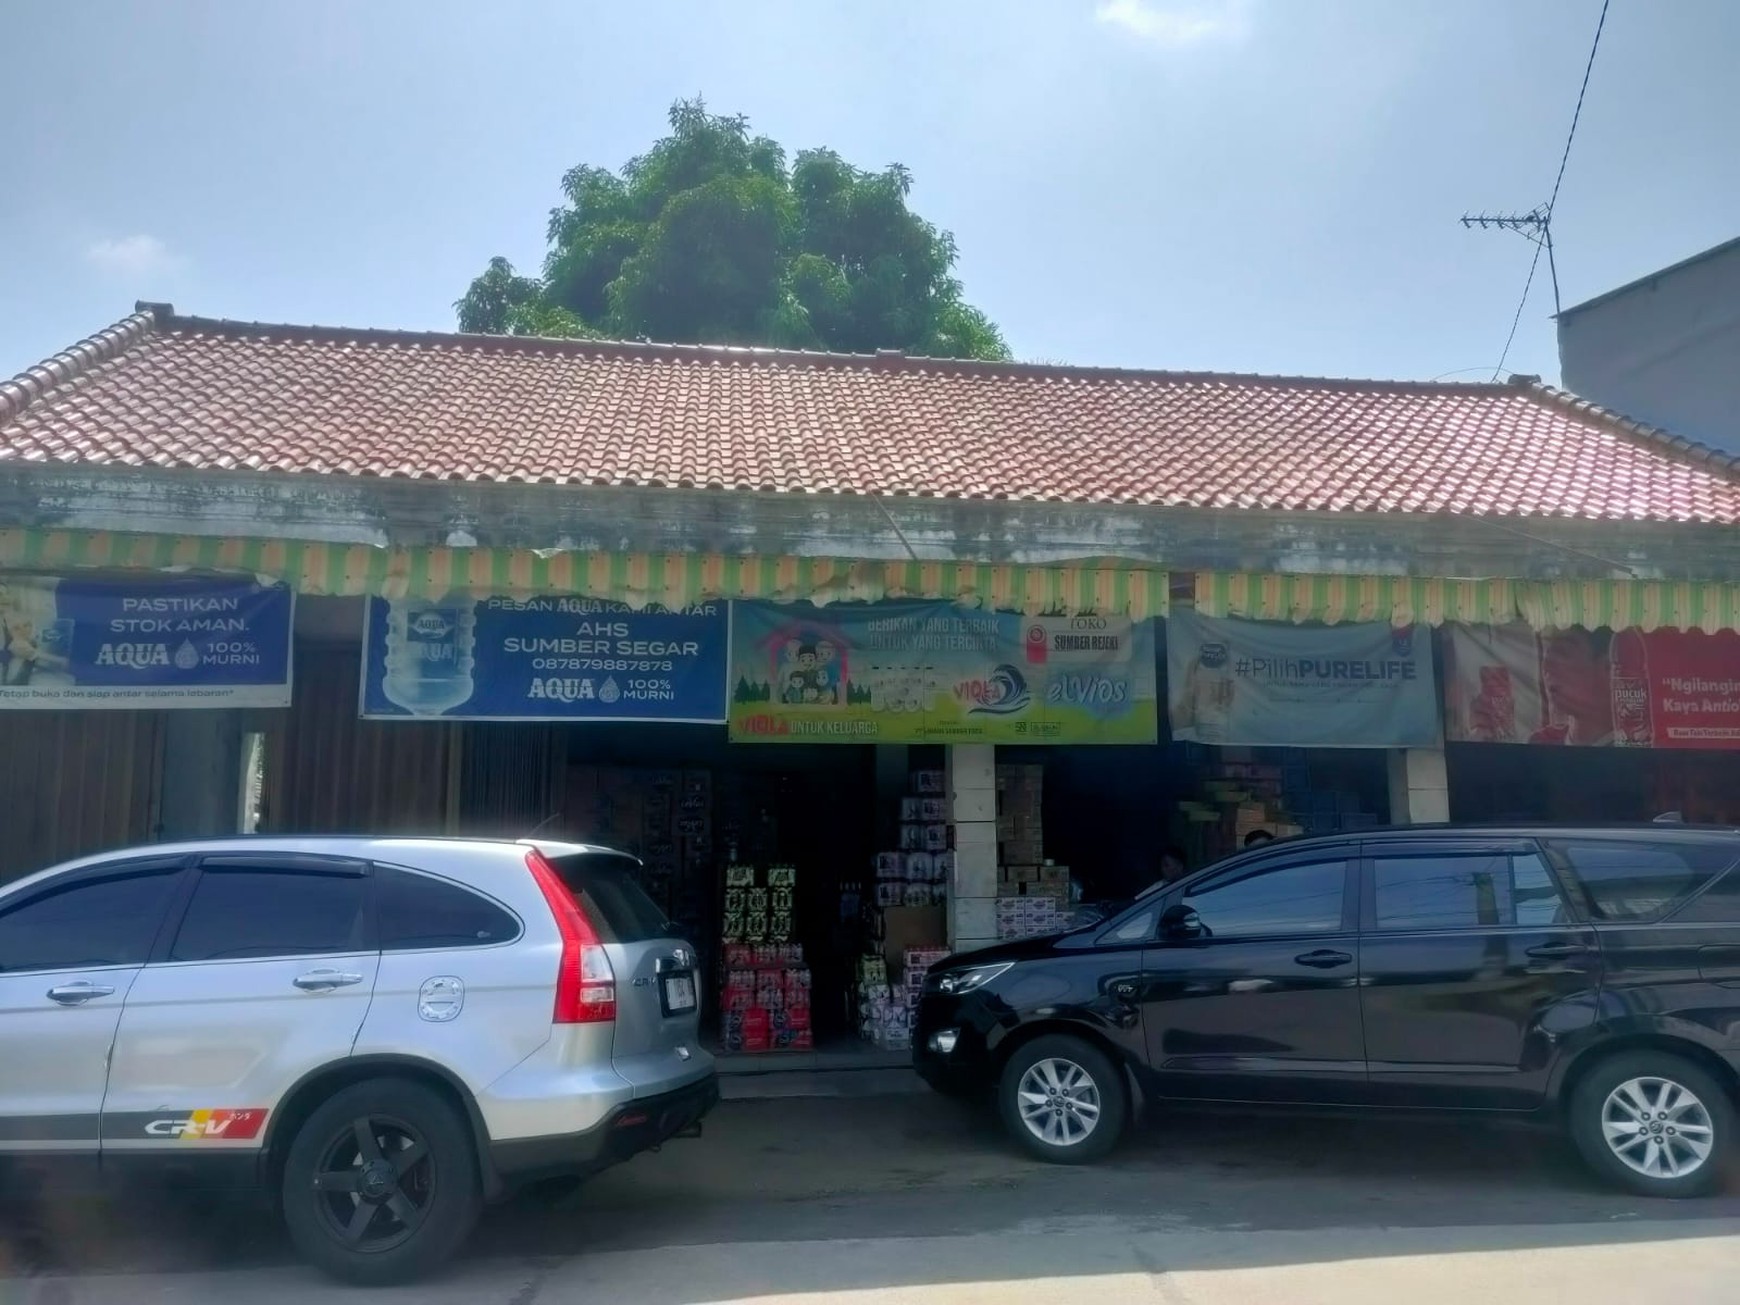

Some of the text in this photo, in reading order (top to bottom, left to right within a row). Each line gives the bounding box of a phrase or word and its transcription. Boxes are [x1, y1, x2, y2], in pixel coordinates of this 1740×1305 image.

[122, 598, 239, 612] PASTIKAN
[488, 600, 552, 612] PESAN
[557, 598, 602, 615] AQUA
[110, 619, 250, 633] STOK AMAN.
[577, 622, 629, 637] AHS
[920, 617, 949, 633] YANG
[953, 618, 1000, 635] TERBAIK
[1070, 617, 1107, 630] TOKO
[207, 642, 256, 653] 100%
[503, 637, 699, 656] SUMBER SEGAR
[912, 635, 941, 650] YANG
[1054, 634, 1090, 650] SUMBER
[95, 643, 170, 669] AQUA
[203, 654, 260, 665] MURNI
[532, 657, 673, 672] 087879887878
[1235, 658, 1417, 680] #PilihPURELIFE
[527, 677, 596, 703] AQUA
[628, 679, 671, 690] 100%
[63, 690, 84, 698] dan
[623, 689, 674, 700] MURNI
[1615, 687, 1648, 703] pucuk
[1663, 698, 1699, 715] Kaya
[791, 721, 824, 734] UNTUK
[826, 721, 878, 735] KELUARGA
[144, 1119, 232, 1135] CR-V
